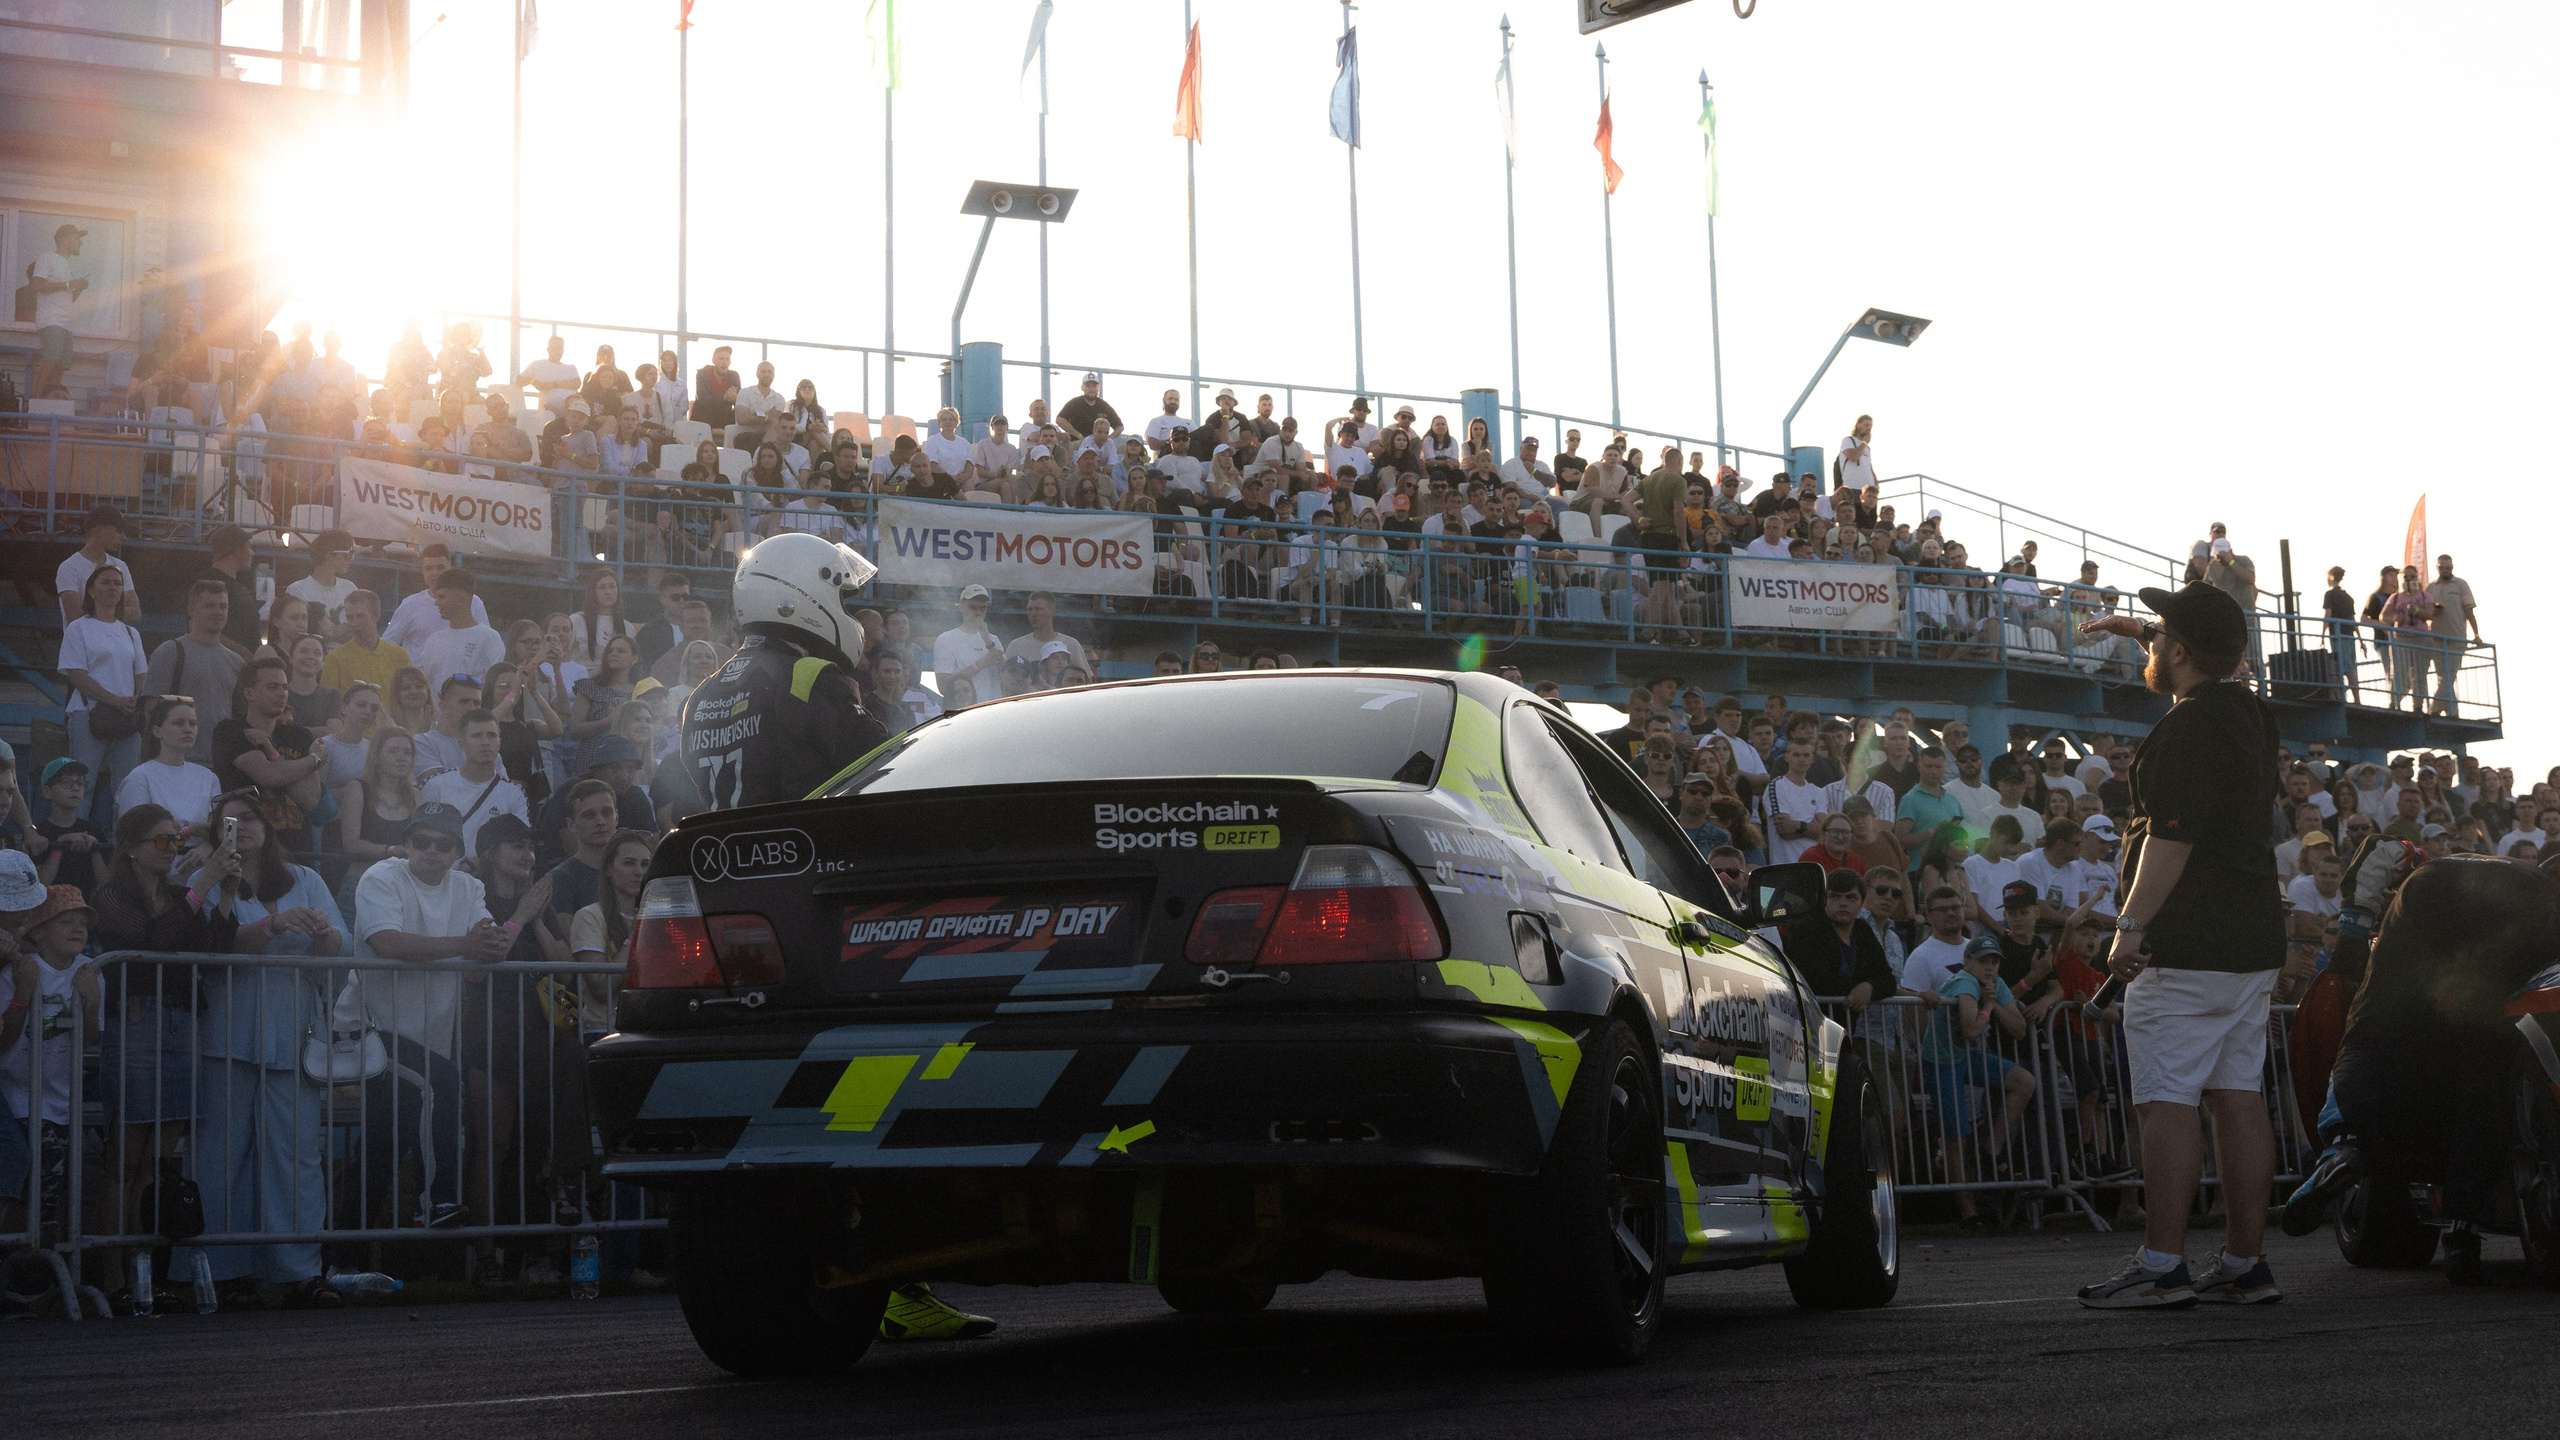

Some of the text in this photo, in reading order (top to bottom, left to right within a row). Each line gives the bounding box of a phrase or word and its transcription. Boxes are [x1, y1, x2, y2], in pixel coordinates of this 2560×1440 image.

[353, 478, 542, 531] WESTMOTORS
[415, 517, 487, 540] Авто из США
[891, 526, 1143, 570] WESTMOTORS
[1739, 577, 1889, 604] WESTMOTORS
[1788, 604, 1848, 617] Авто из США
[726, 659, 750, 673] OMP
[694, 706, 730, 722] Sports
[698, 748, 743, 812] 77
[1094, 800, 1259, 823] Blockchain
[1096, 827, 1269, 852] Sports DRIFT
[1424, 830, 1457, 855] НА
[1453, 834, 1515, 863] ШИНАХ
[701, 841, 854, 873] X LABS inc.
[850, 906, 1119, 943] ШКОЛА ДРИФТА JP DAY
[1659, 967, 1763, 1043] Blockchain
[1672, 1048, 1735, 1120] Sports
[1741, 1072, 1769, 1107] DRIFT
